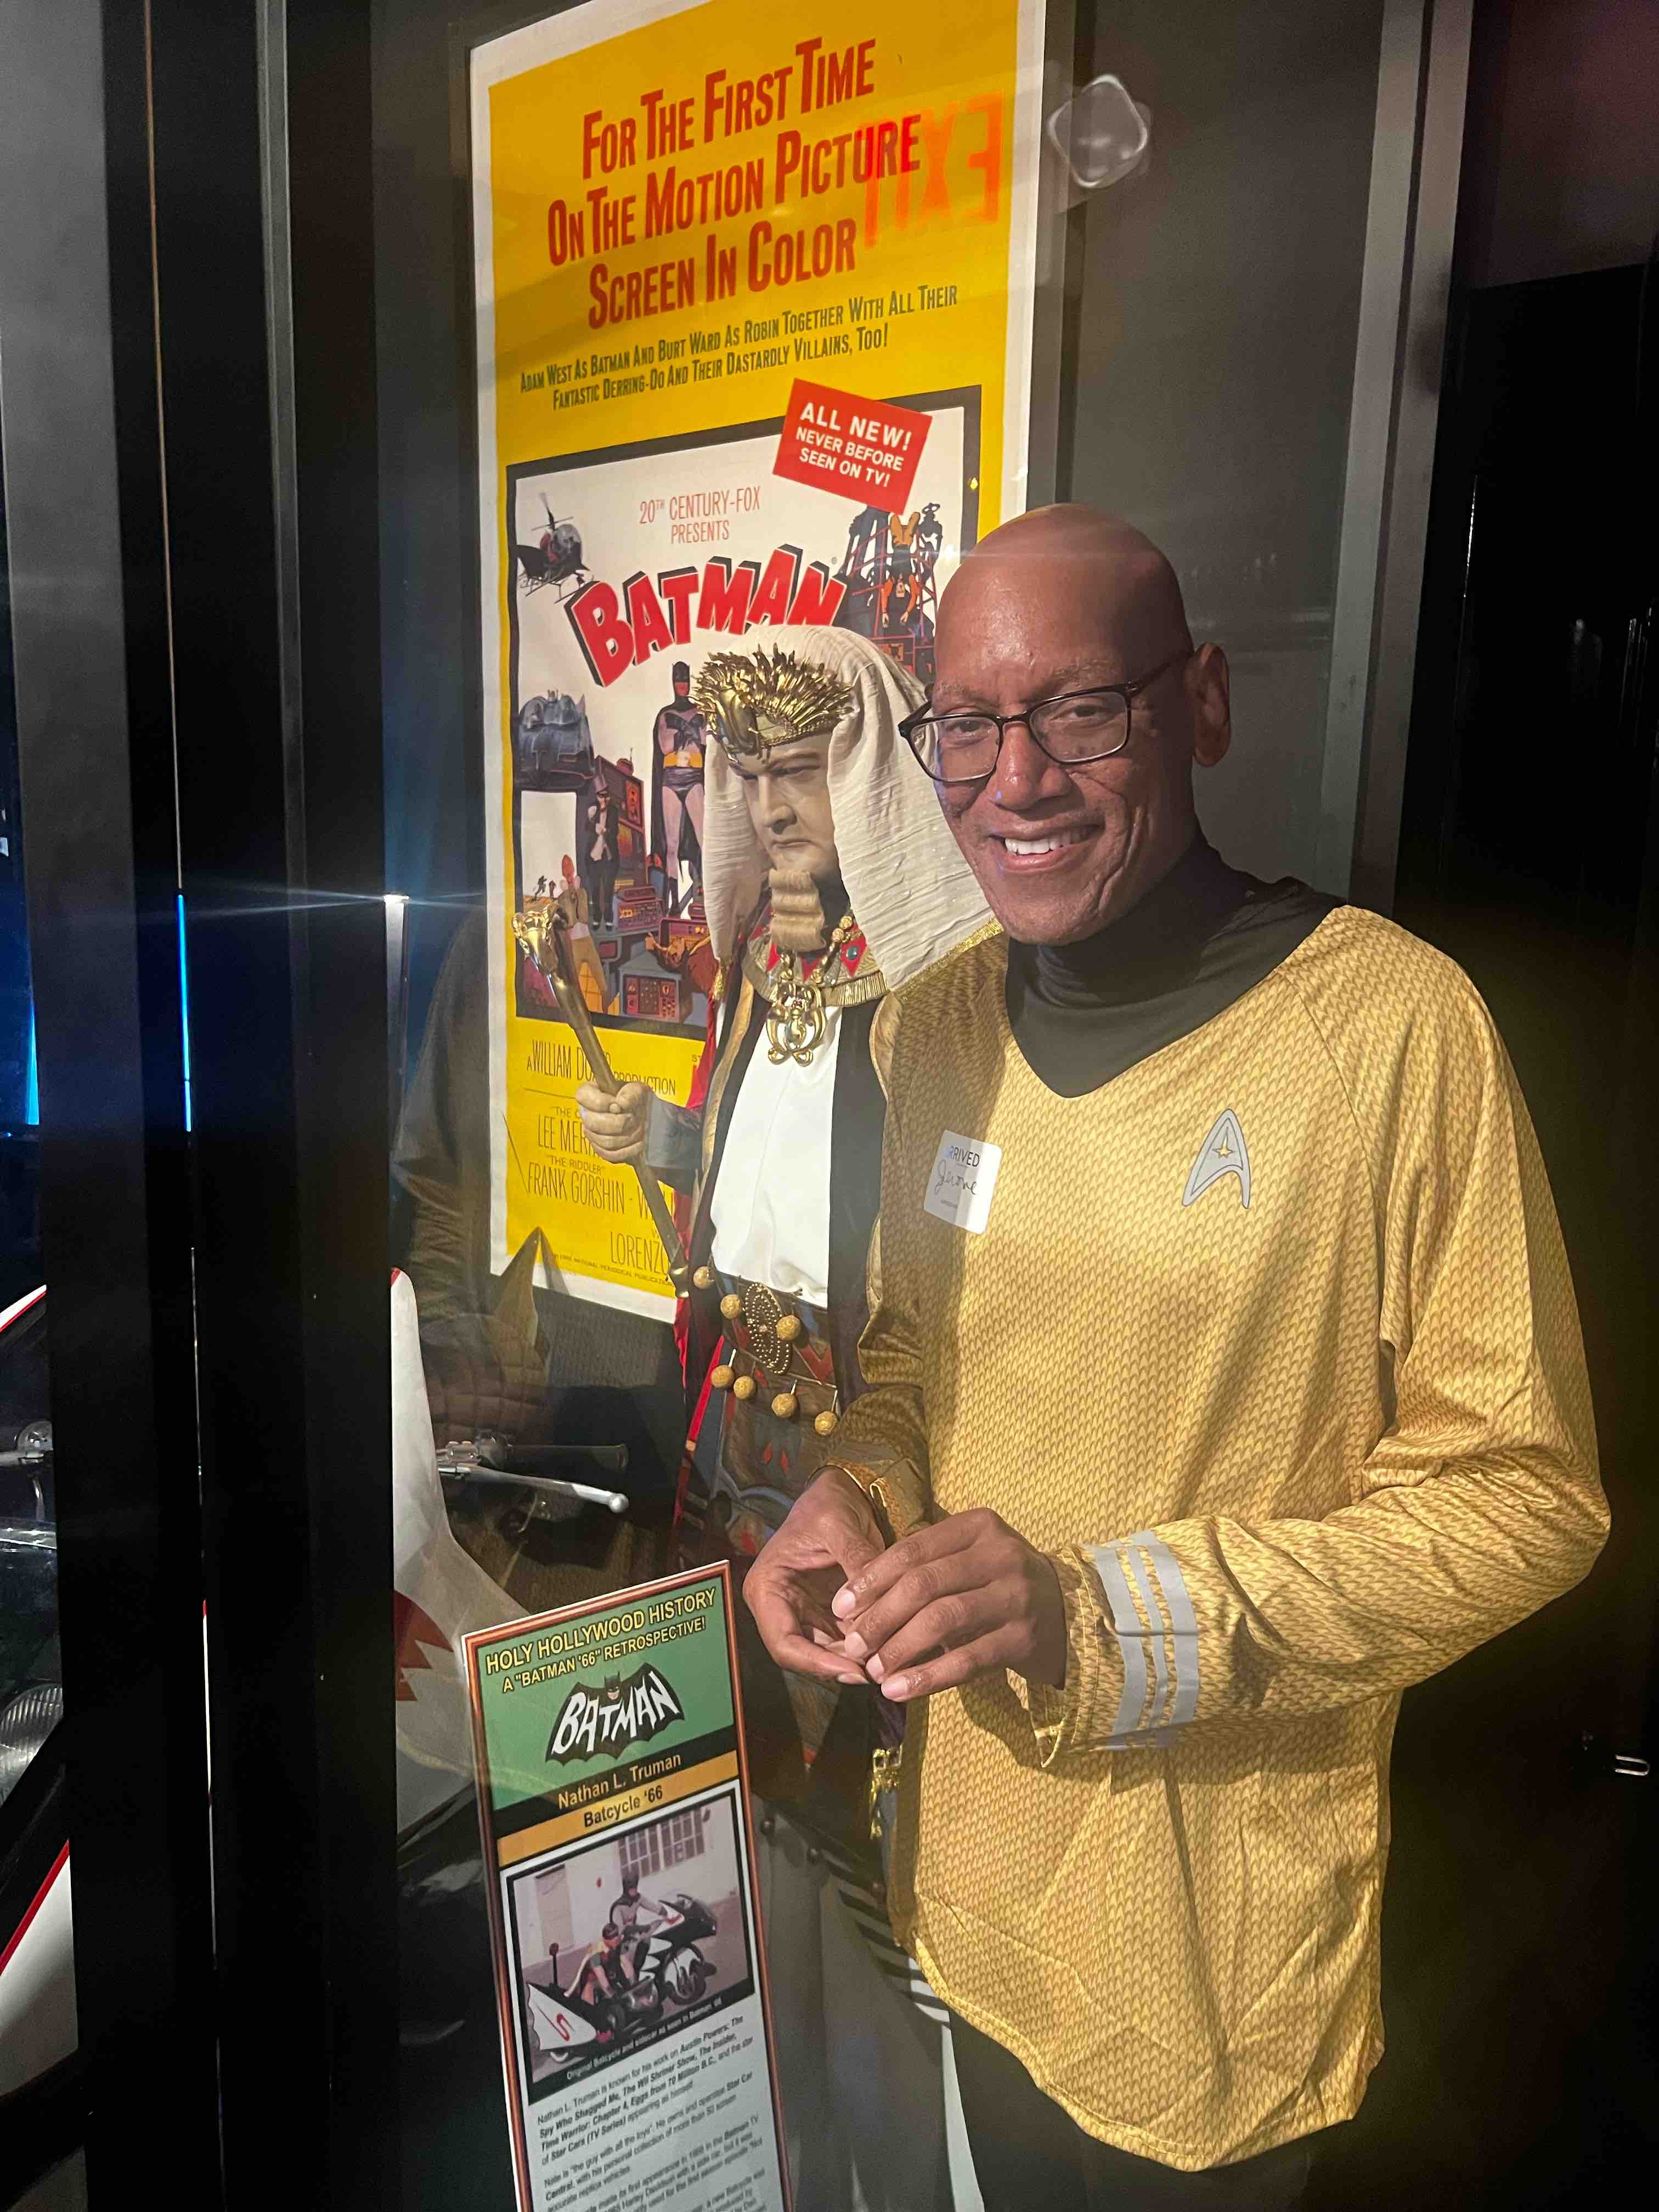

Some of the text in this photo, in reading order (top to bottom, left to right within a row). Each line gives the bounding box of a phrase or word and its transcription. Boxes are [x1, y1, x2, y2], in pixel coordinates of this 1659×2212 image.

[583, 37, 876, 179] FOR THE FIRST TIME
[549, 114, 921, 266] ON THE MOTION PICTURE
[588, 218, 856, 329] SCREEN IN COLOR
[521, 284, 957, 393] ADAM WEST AS BATMAN AND BURT WARD AS ROBIN TOGETHER WITH ALL THEIR
[553, 322, 888, 411] FANTASTIC DERRING-DO AND THEIR DASTARDLY VILLAINS, TOO!
[796, 426, 904, 472] NEVER BEFORE
[800, 402, 912, 452] ALL NEW!
[799, 447, 890, 487] SEEN ON TV!
[669, 486, 760, 520] CENTURY-FOX
[671, 520, 729, 544] PRESENTS
[566, 544, 847, 687] BATMAN
[532, 1039, 572, 1081] WILLIAM
[538, 1114, 556, 1150] LEE
[527, 1161, 567, 1200] FRANK
[571, 1171, 625, 1215] GORSHIN
[486, 1587, 716, 1675] HOLY HOLLYWOOD HISTORY
[503, 1678, 514, 1694] A
[516, 1657, 575, 1688] "BATMAN
[603, 1616, 706, 1661] RETROSPECTIVE!
[551, 1671, 680, 1755] BATMAN
[558, 1753, 681, 1810] Nathan L. Truman
[584, 1792, 641, 1829] Batcycle
